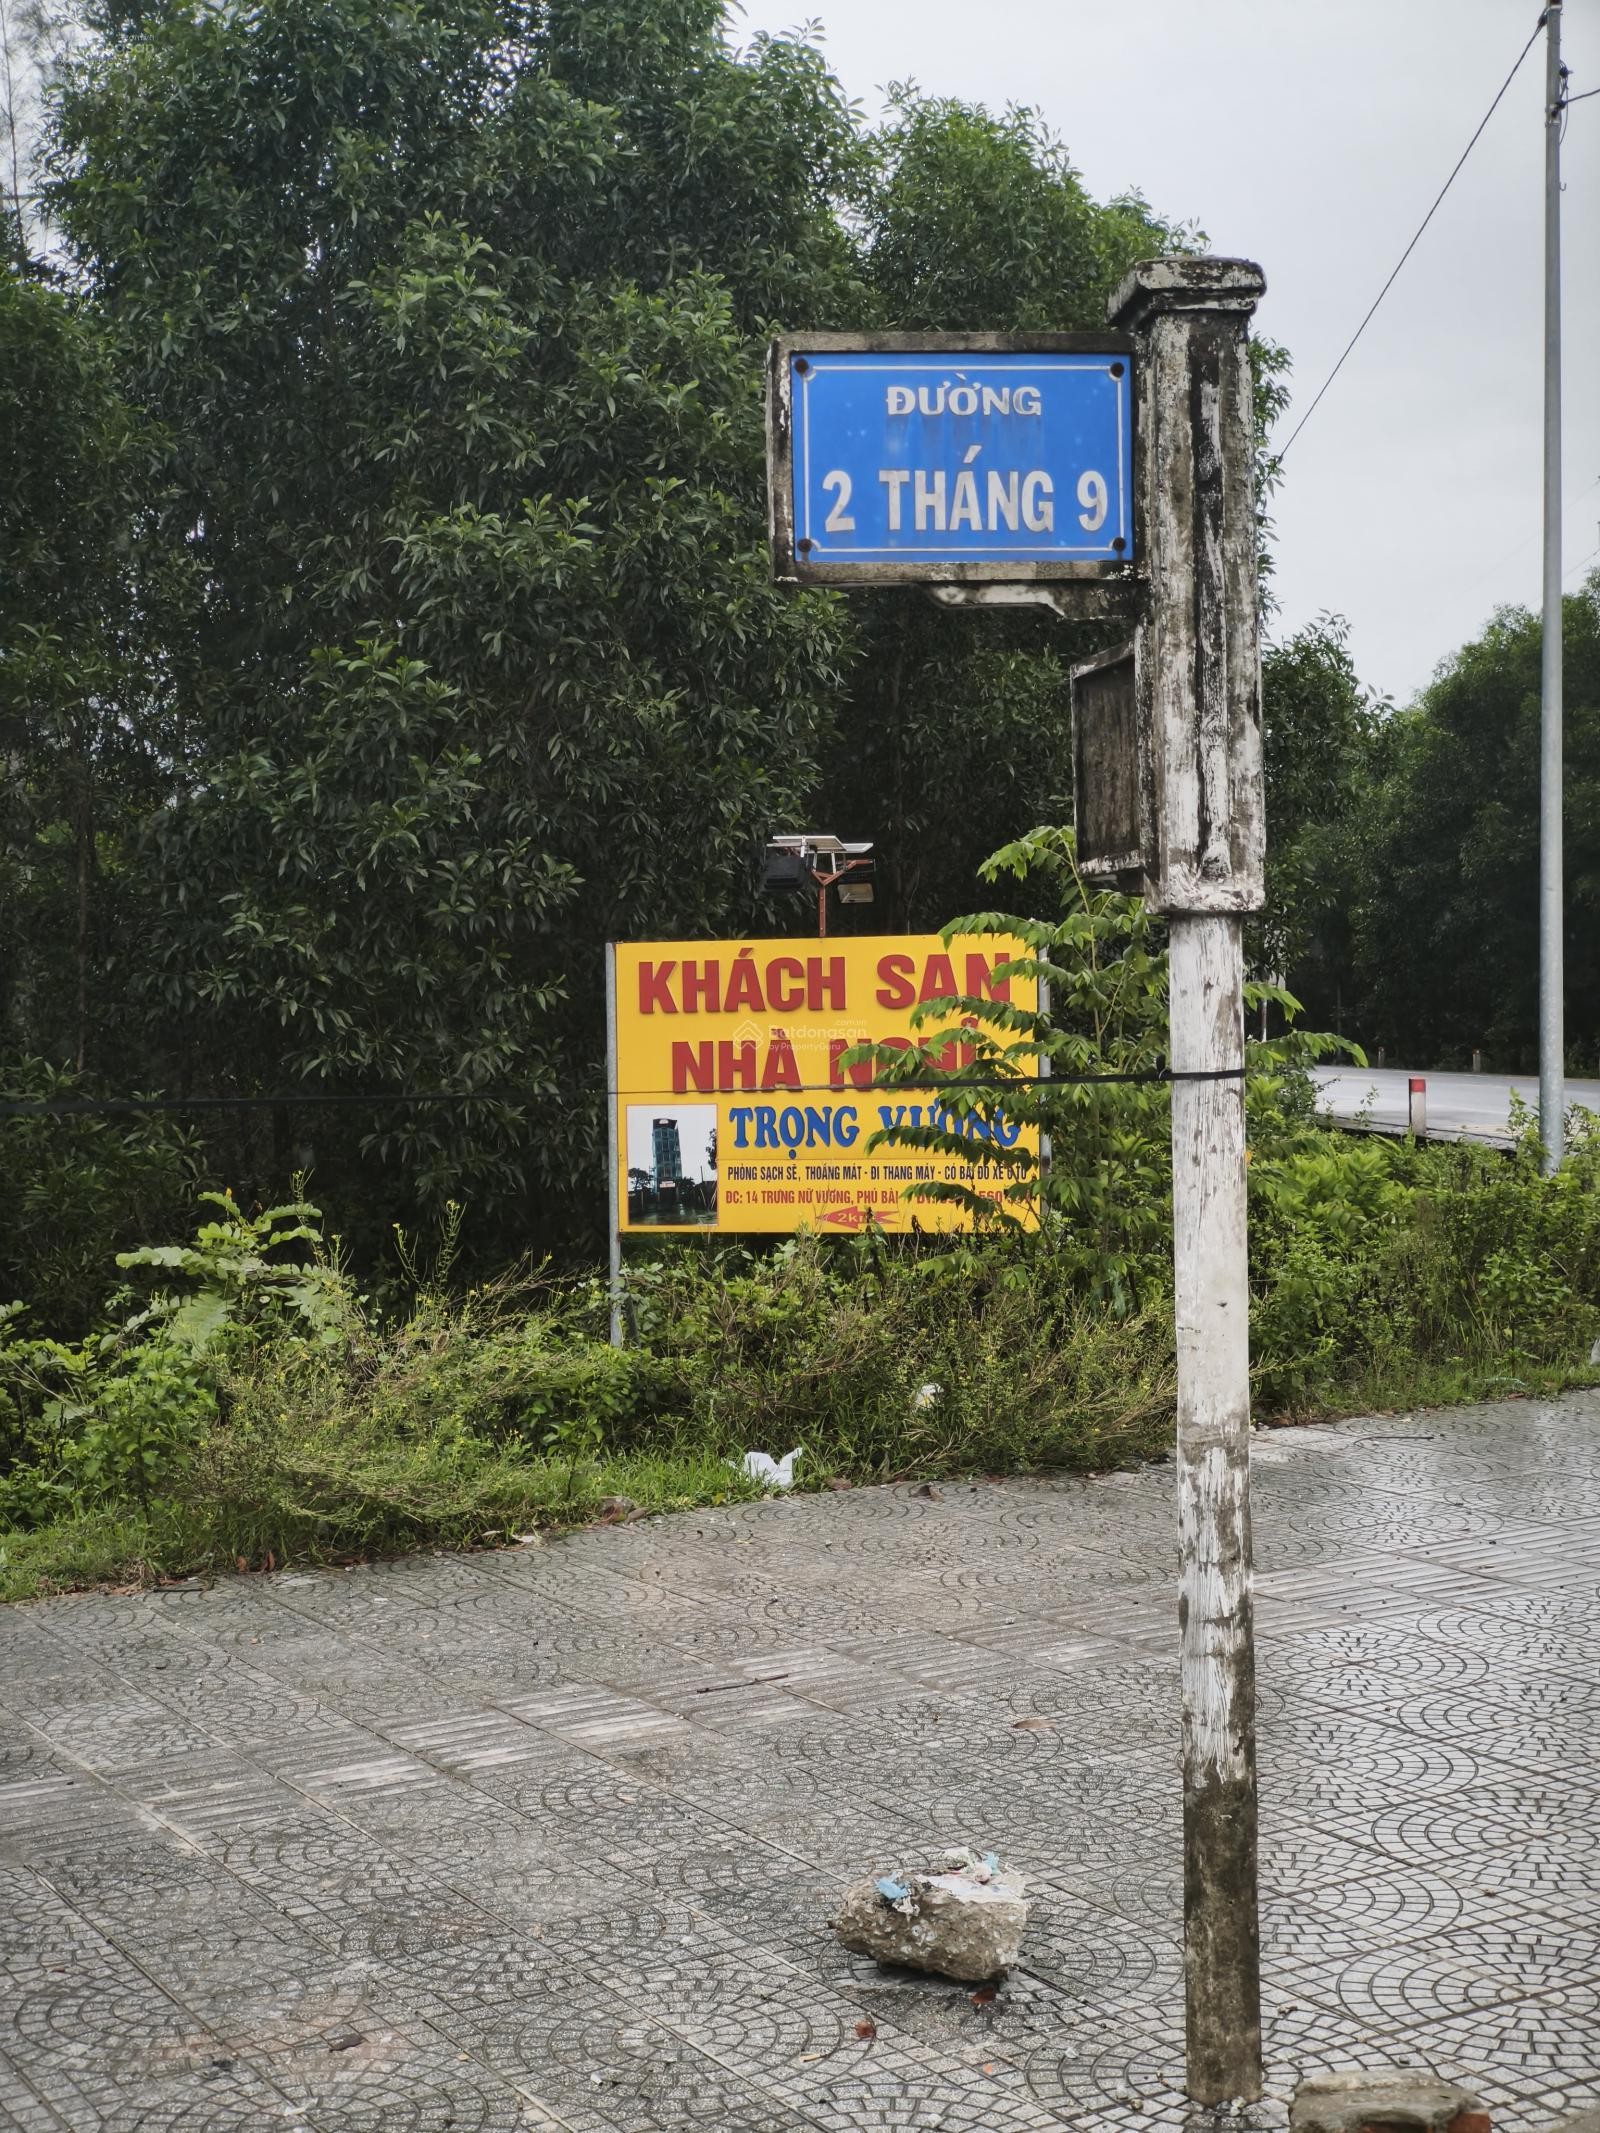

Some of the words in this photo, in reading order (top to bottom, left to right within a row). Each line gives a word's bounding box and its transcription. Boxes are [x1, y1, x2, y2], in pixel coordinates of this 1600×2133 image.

[886, 373, 1042, 416] ĐƯỜNG
[822, 470, 856, 533] 2
[879, 445, 1055, 533] THÁNG
[1076, 470, 1108, 532] 9
[638, 947, 847, 1014] KHÁCH
[671, 1028, 804, 1094] NHÀ
[728, 1105, 861, 1160] TRỌNG
[746, 1190, 758, 1204] 14
[760, 1166, 784, 1183] SẠCH
[883, 1165, 913, 1180] THANG
